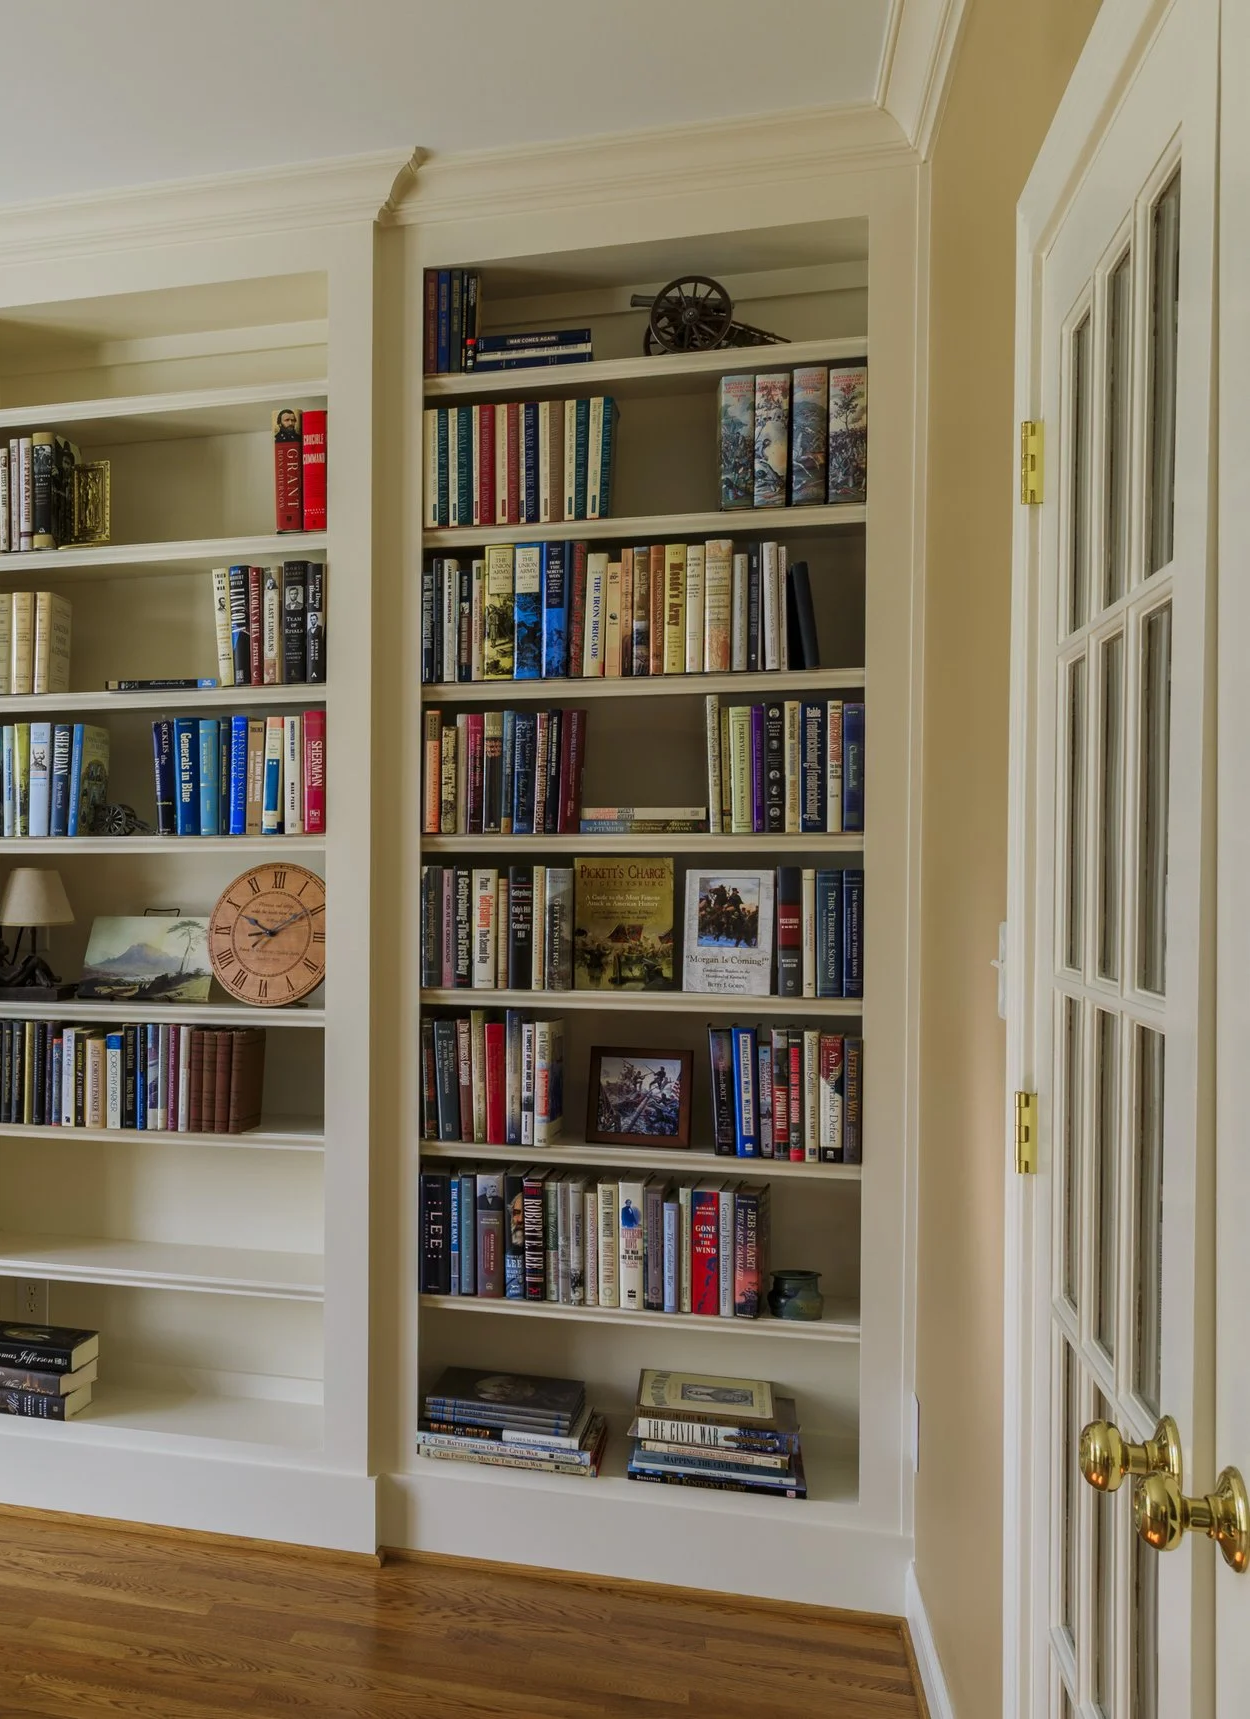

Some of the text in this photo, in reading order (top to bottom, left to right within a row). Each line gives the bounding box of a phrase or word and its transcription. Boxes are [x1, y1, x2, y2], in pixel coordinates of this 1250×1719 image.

[459, 413, 467, 450] ORDEAL
[526, 408, 534, 425] THE
[459, 453, 467, 463] OF
[526, 450, 534, 467] FOR
[287, 449, 298, 508] GRANT
[459, 468, 467, 486] THE
[526, 470, 534, 487] THE
[251, 584, 259, 620] LINCOLN'S
[668, 563, 684, 626] Meade's Army
[591, 621, 600, 659] BRIGADE
[54, 731, 69, 775] SHERIDAN
[515, 721, 526, 771] Richmond
[539, 729, 547, 766] PENINSULA
[830, 713, 842, 762] Chancellorsville
[181, 733, 192, 802] Generals in Blue
[312, 741, 322, 786] SHERMAN
[247, 877, 260, 896] XI
[272, 871, 286, 888] XII
[478, 895, 493, 928] Gettysburg
[215, 925, 231, 935] IX
[480, 930, 490, 938] The
[479, 939, 490, 955] Second
[258, 980, 267, 997] VI
[807, 1035, 817, 1069] American
[791, 1074, 799, 1083] ON
[848, 1081, 857, 1096] THE
[776, 1090, 786, 1129] APPOMATTOX
[430, 1212, 442, 1248] LEE
[524, 1198, 543, 1269] ROBERT E. LEE
[747, 1208, 756, 1269] JEB STUART
[15, 1350, 53, 1368] Jefferson
[648, 1420, 719, 1446] THE CIVIL WAR
